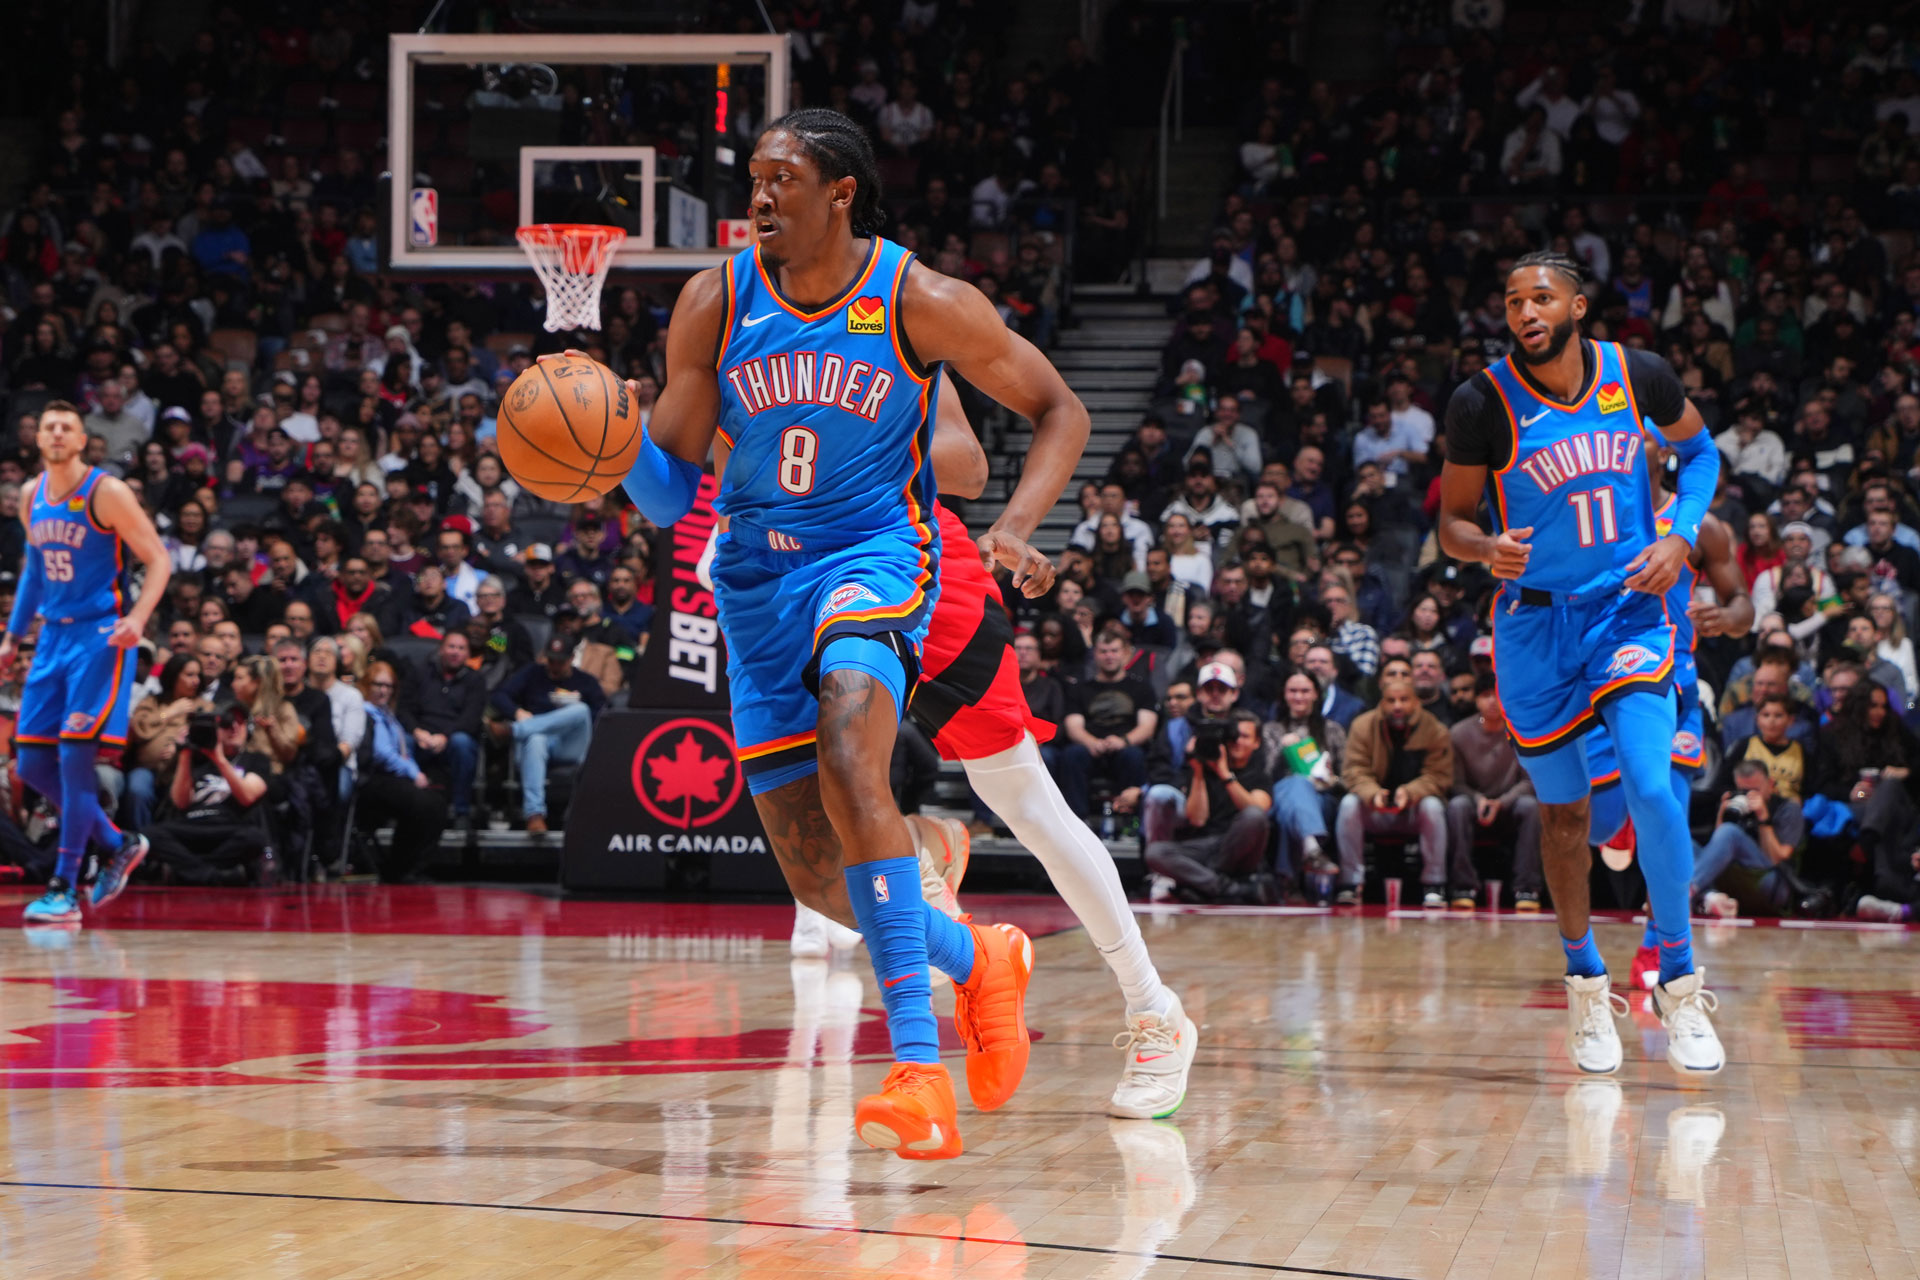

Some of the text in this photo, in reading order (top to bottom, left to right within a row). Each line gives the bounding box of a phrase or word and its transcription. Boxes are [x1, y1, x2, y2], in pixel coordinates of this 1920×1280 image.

[726, 351, 894, 423] THUNDER
[778, 426, 819, 496] 8
[1519, 431, 1641, 494] THUNDER
[768, 529, 803, 551] OKC
[1568, 486, 1618, 548] 11
[42, 550, 74, 582] 55
[607, 834, 767, 854] AIR CANADA
